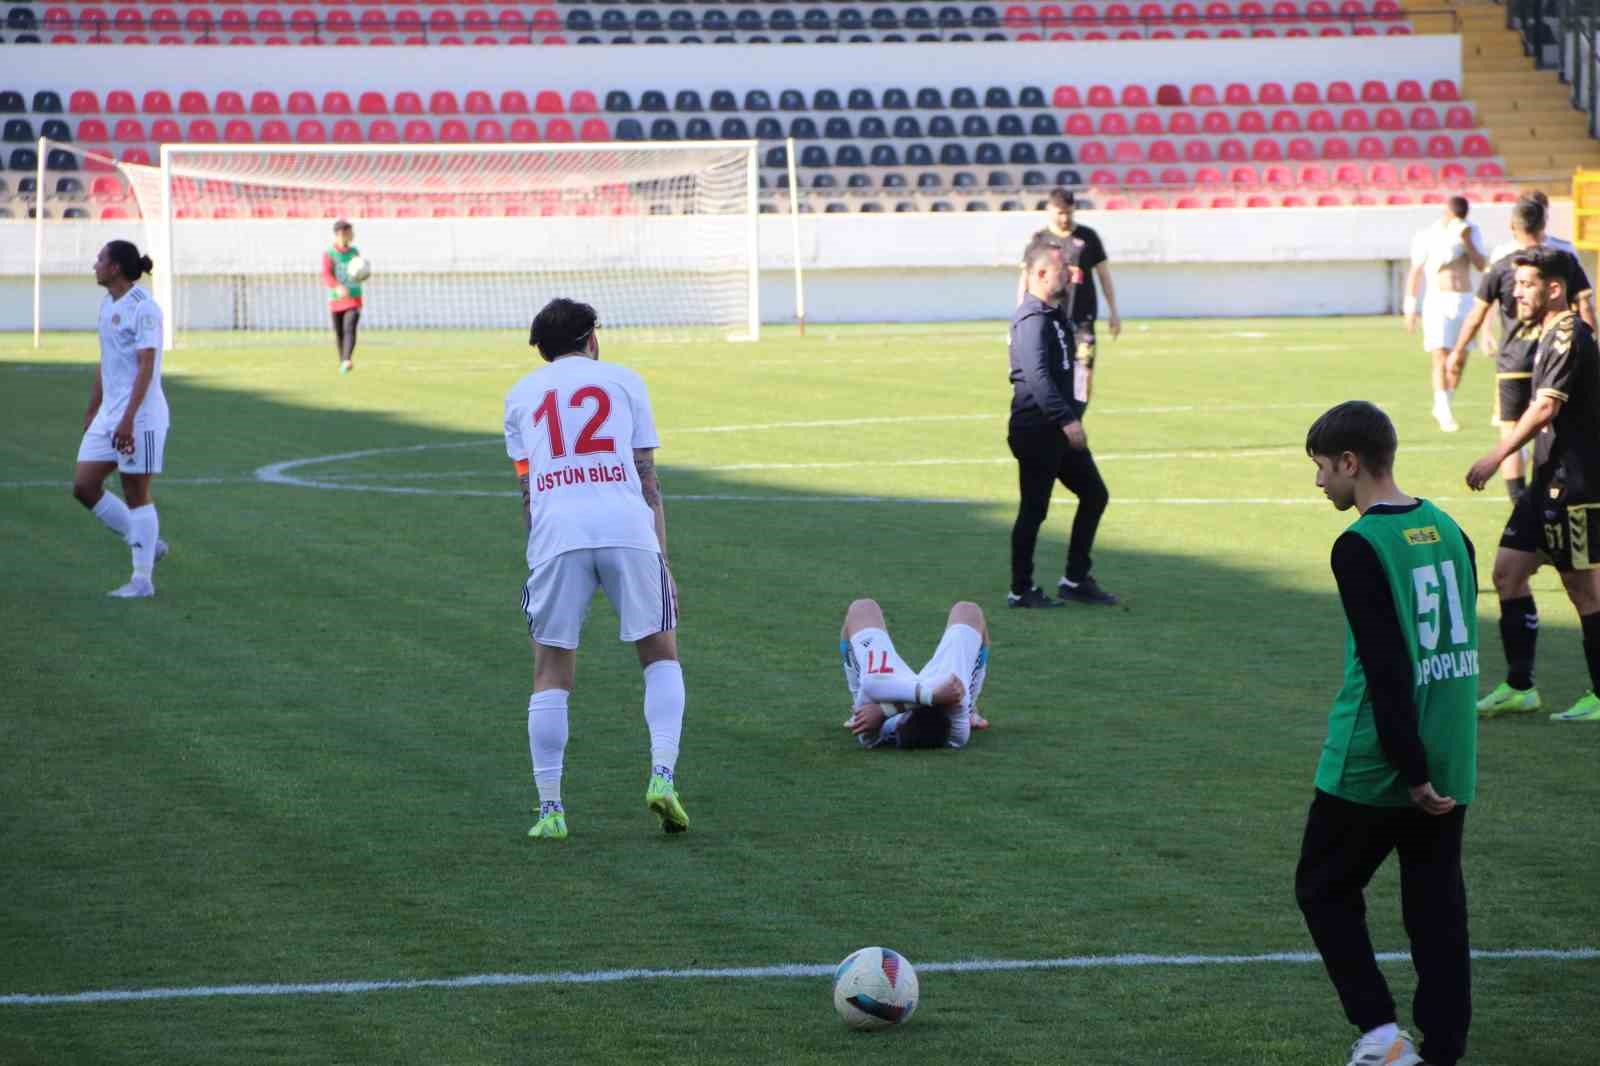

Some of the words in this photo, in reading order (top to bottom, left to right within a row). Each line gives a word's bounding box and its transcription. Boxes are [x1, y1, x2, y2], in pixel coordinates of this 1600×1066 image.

[533, 384, 617, 459] 12
[537, 466, 585, 492] ÜSTÜN
[589, 463, 626, 482] BİLGİ
[1412, 560, 1468, 650] 51
[868, 650, 894, 674] 77
